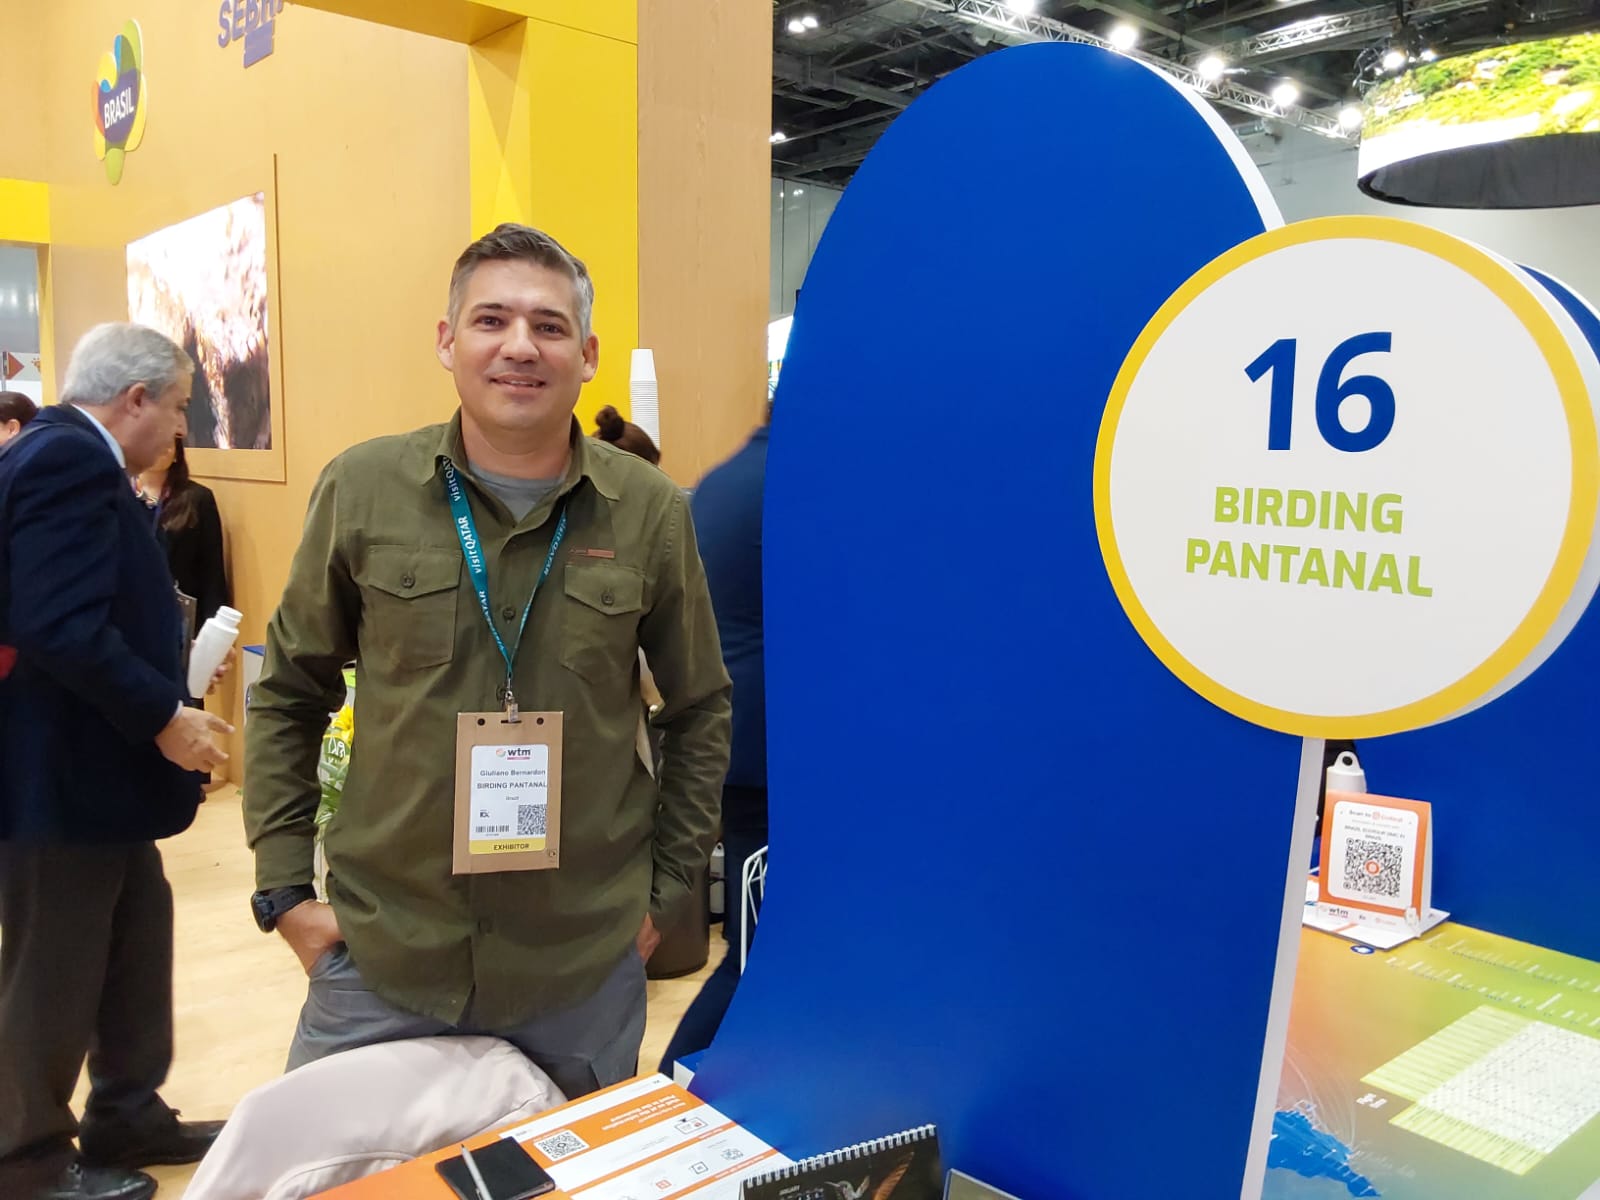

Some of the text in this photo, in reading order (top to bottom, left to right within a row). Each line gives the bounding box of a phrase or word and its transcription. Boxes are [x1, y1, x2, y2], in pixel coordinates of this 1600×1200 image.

[104, 87, 134, 129] BRASIL
[1244, 331, 1396, 453] 16
[1214, 486, 1404, 534] BIRDING
[458, 515, 482, 574] visitQATAR
[1185, 537, 1433, 598] PANTANAL
[480, 768, 546, 777] Giuliano Bernardon
[507, 747, 531, 756] wtm
[493, 843, 530, 851] EXHIBITOR
